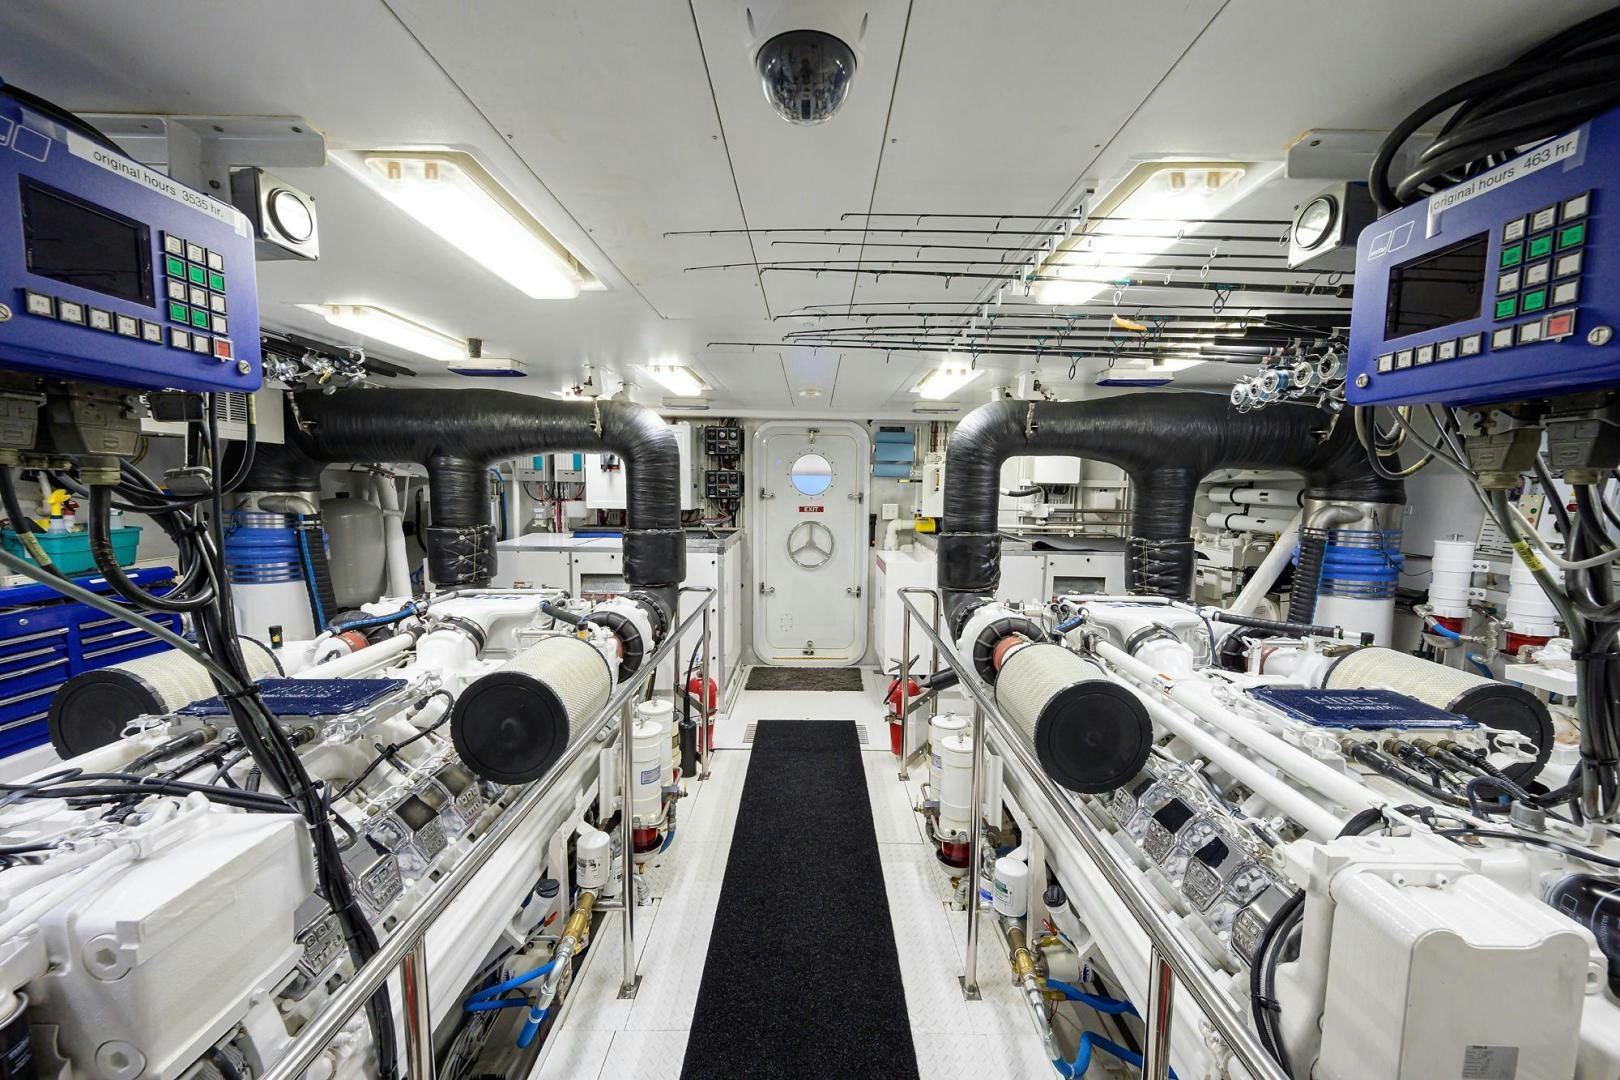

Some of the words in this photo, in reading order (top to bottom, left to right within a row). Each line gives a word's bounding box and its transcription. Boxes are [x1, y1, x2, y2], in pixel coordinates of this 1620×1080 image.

[93, 151, 140, 179] original
[144, 172, 176, 196] hours
[182, 190, 208, 210] 3535
[210, 202, 224, 218] hr.
[1433, 183, 1475, 210] original
[1479, 167, 1514, 190] hours
[1523, 148, 1550, 169] 463
[1555, 140, 1576, 156] hr.
